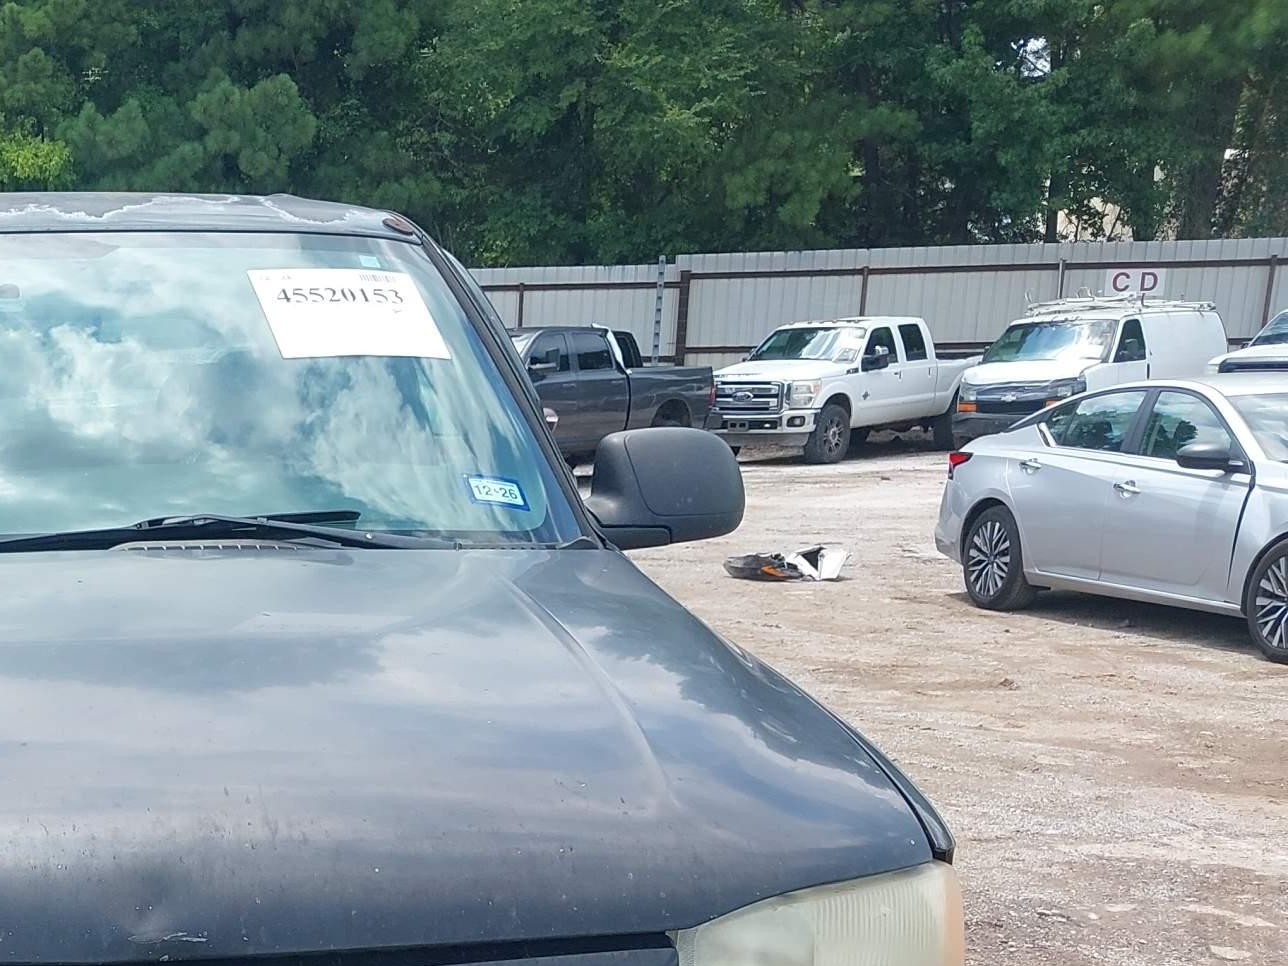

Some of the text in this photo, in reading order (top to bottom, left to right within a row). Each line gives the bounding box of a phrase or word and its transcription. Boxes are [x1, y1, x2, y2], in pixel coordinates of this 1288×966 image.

[1112, 271, 1158, 292] C D
[276, 287, 404, 304] 45520153
